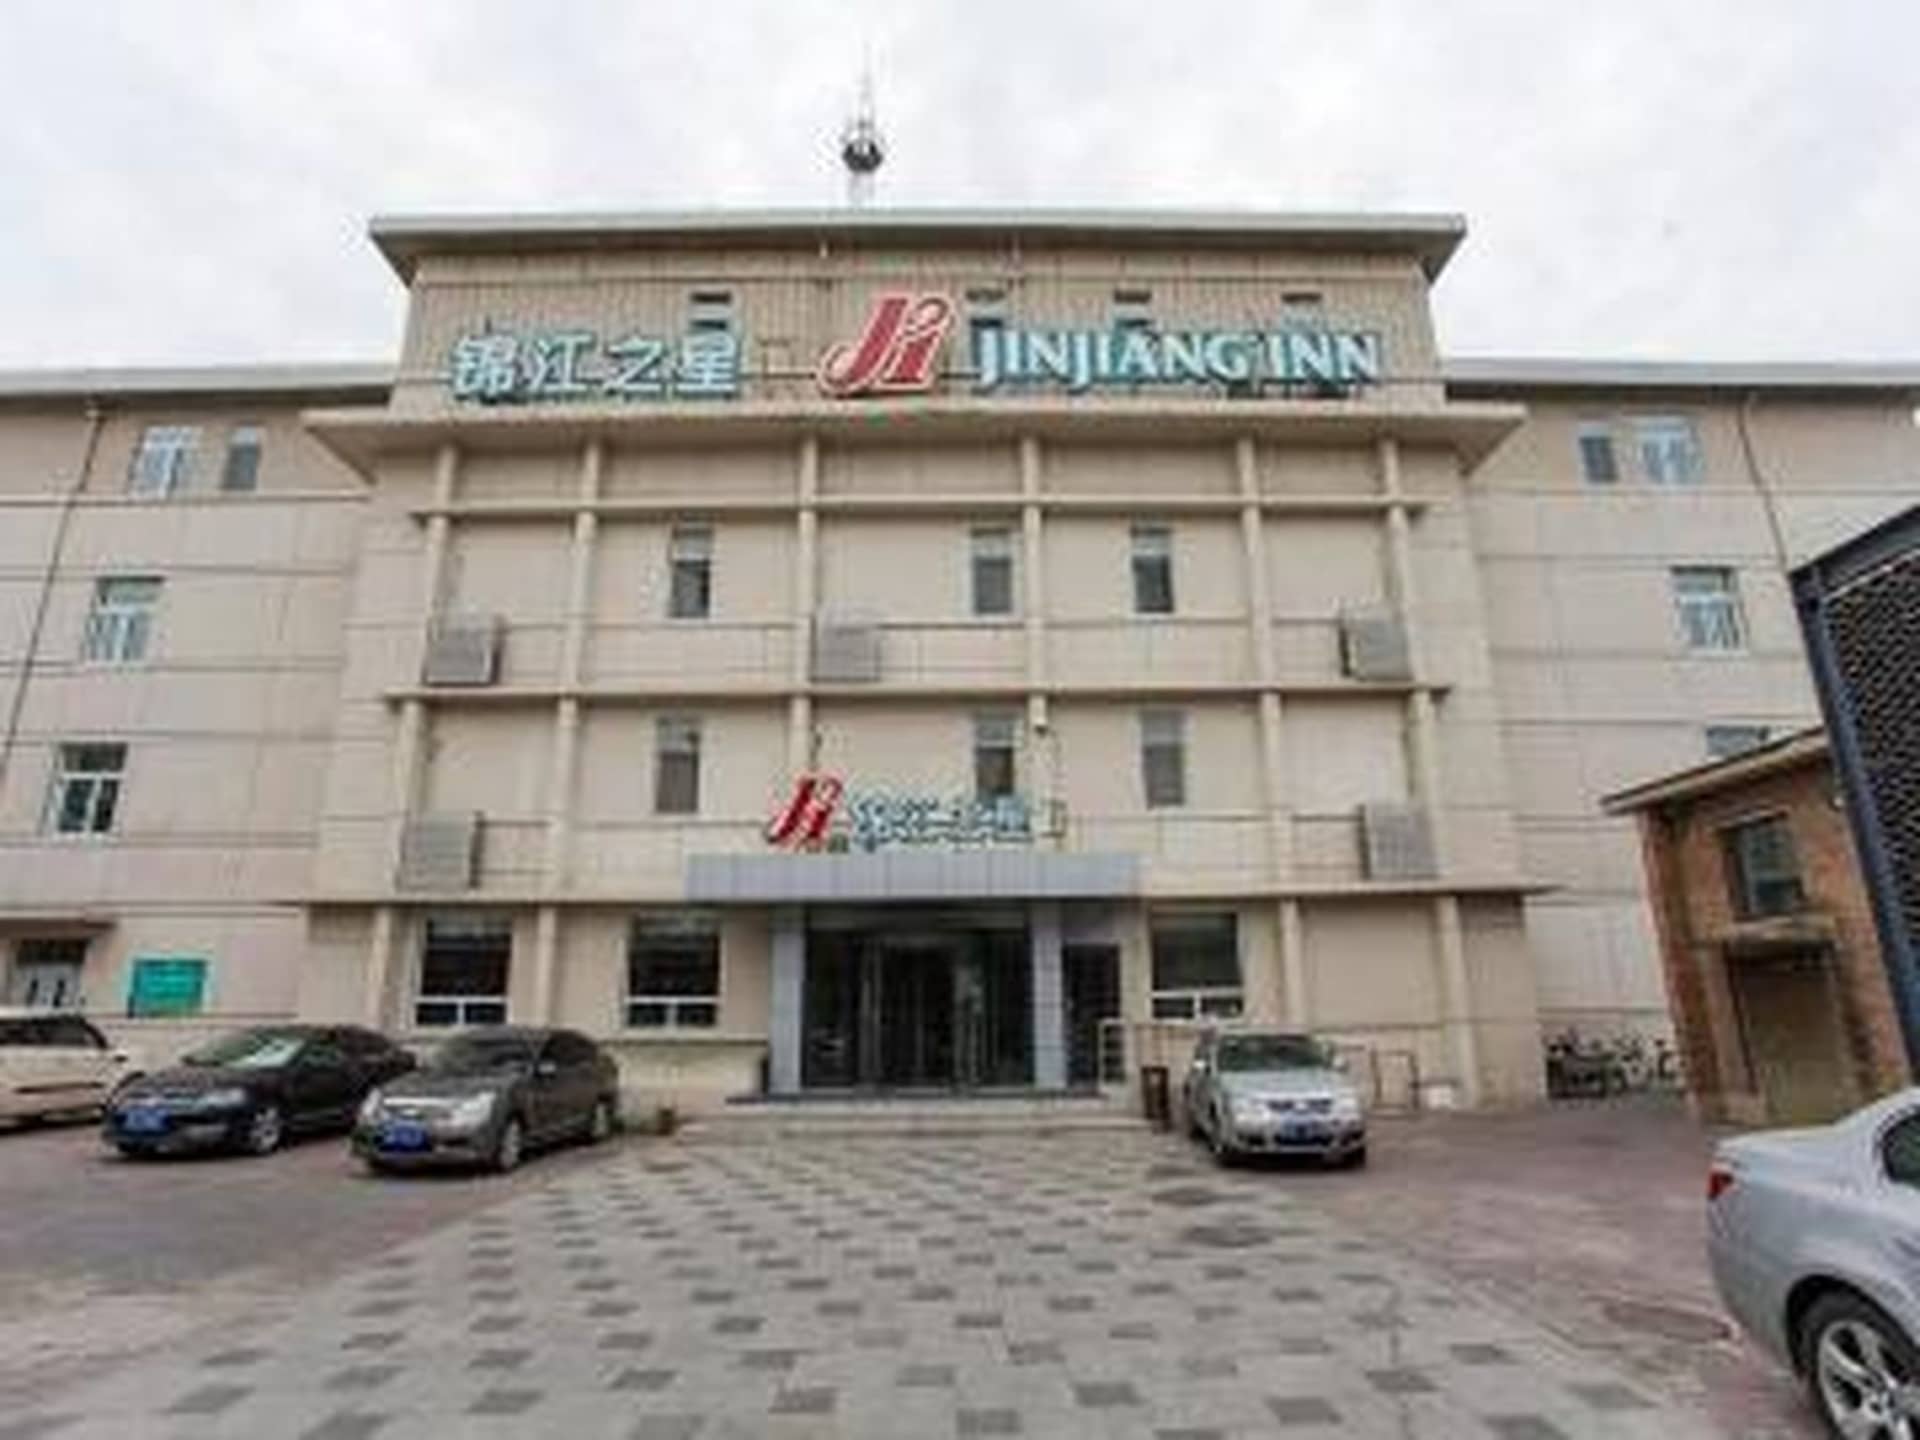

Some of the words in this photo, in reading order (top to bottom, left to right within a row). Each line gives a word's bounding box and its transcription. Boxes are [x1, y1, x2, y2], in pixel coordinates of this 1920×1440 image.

[453, 332, 738, 396] 锦江之星
[976, 330, 1250, 388] JINJIANG
[1269, 331, 1380, 380] INN
